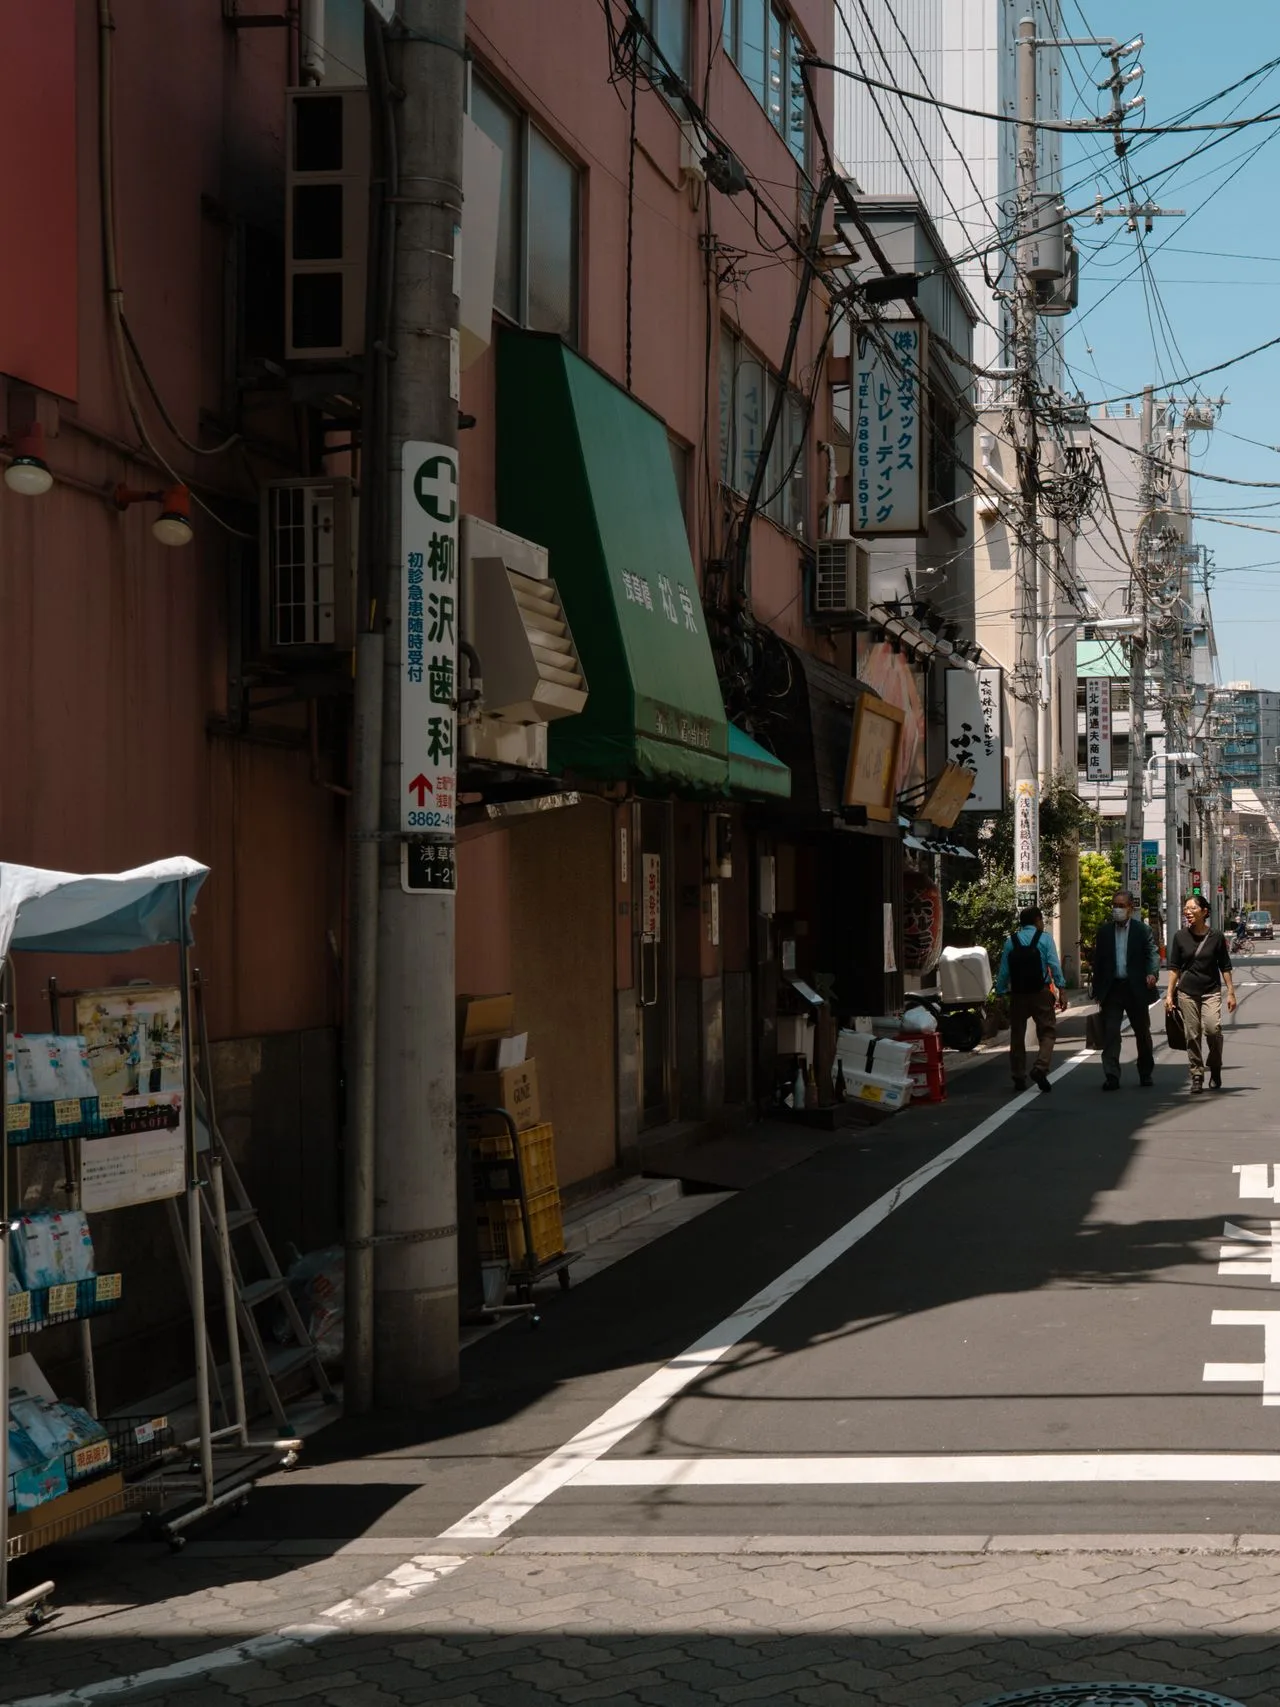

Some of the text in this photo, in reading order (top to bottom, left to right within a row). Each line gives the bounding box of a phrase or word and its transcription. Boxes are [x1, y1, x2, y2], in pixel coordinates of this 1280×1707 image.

[876, 383, 893, 523] トレーディング
[408, 552, 424, 683] 初診急患随時受付
[427, 531, 455, 768] 柳沢歯科
